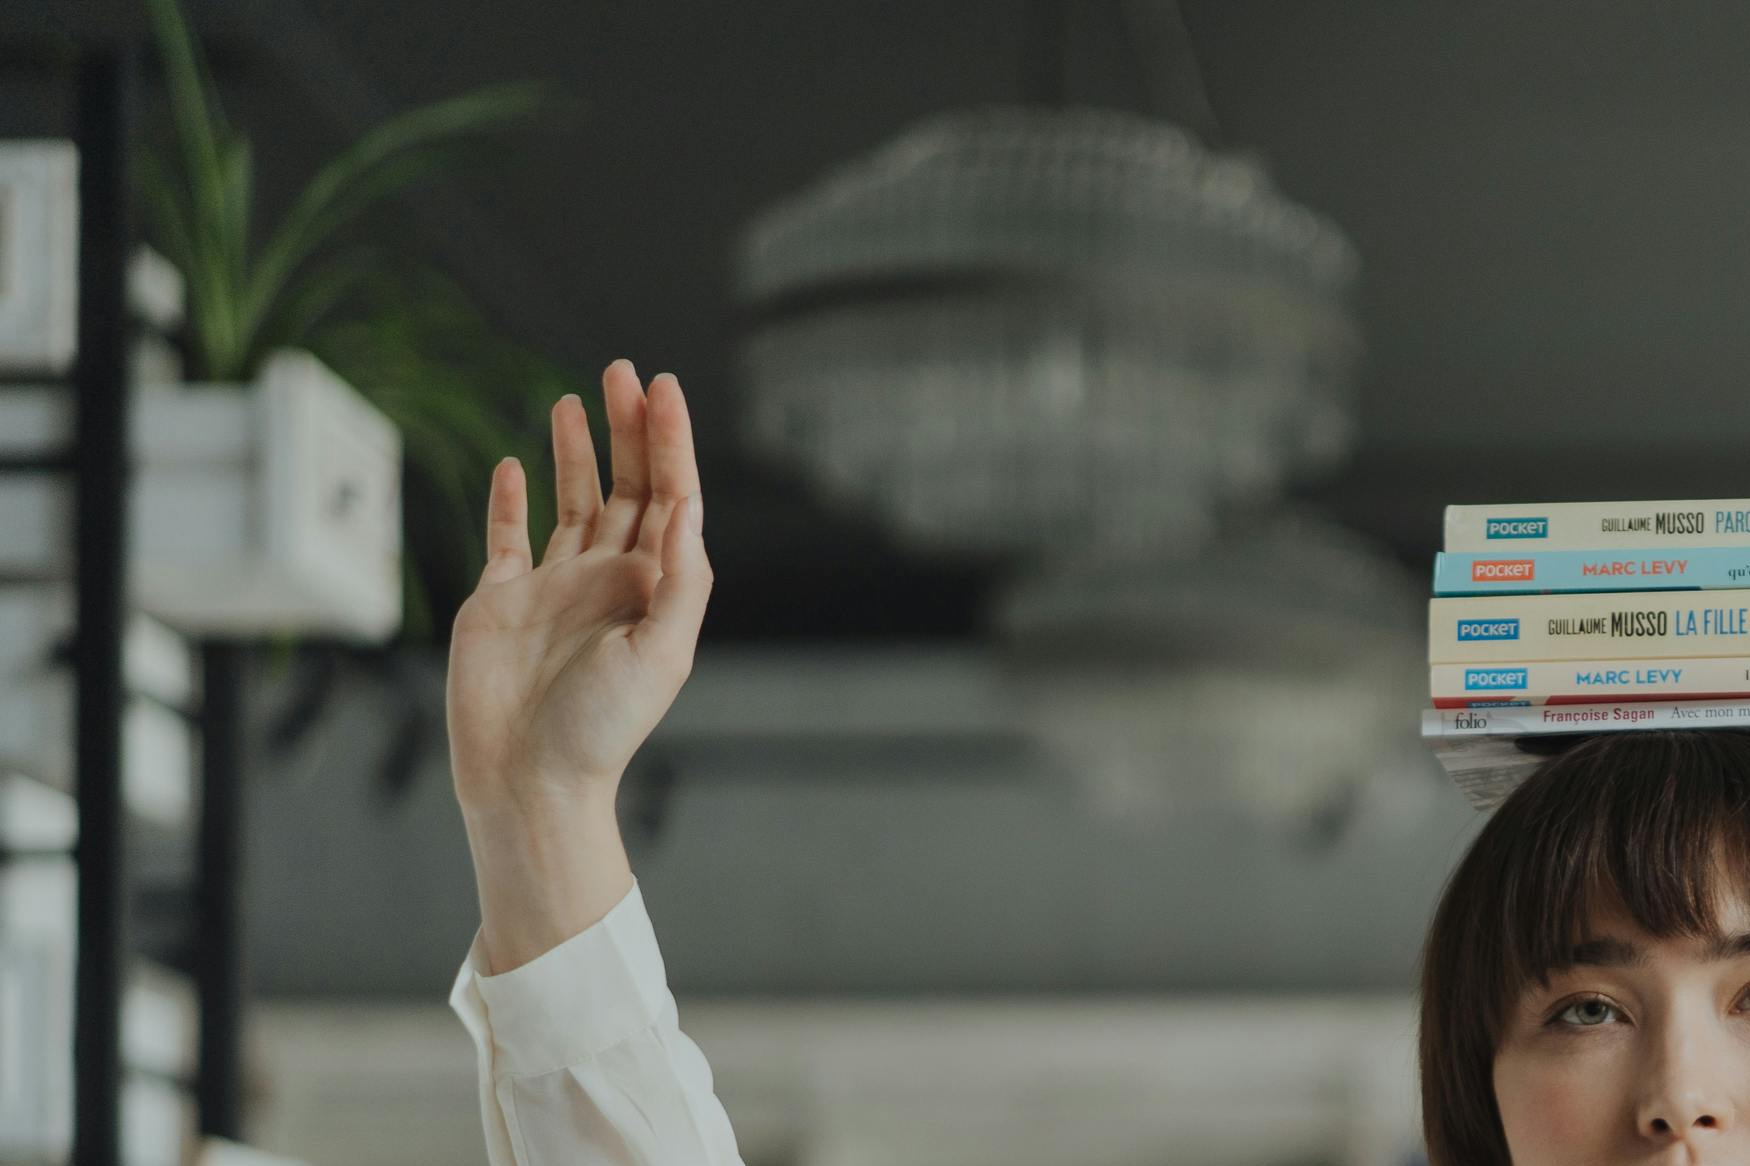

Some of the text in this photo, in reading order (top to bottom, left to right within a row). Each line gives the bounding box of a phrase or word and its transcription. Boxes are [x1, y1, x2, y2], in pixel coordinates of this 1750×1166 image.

[1601, 517, 1651, 532] GUILLAUME
[1655, 511, 1705, 534] MUSSO
[1582, 560, 1688, 576] MARC LEVY
[1547, 617, 1607, 635] GUILLAUME
[1611, 610, 1667, 637] MUSSO
[1675, 609, 1698, 636] LA
[1703, 608, 1748, 635] FILLE
[1576, 668, 1683, 685] MARC LEVY
[1455, 712, 1488, 730] folio
[1543, 707, 1655, 725] Françoise Sagan
[1671, 705, 1701, 719] Avec
[1705, 707, 1734, 718] mon
